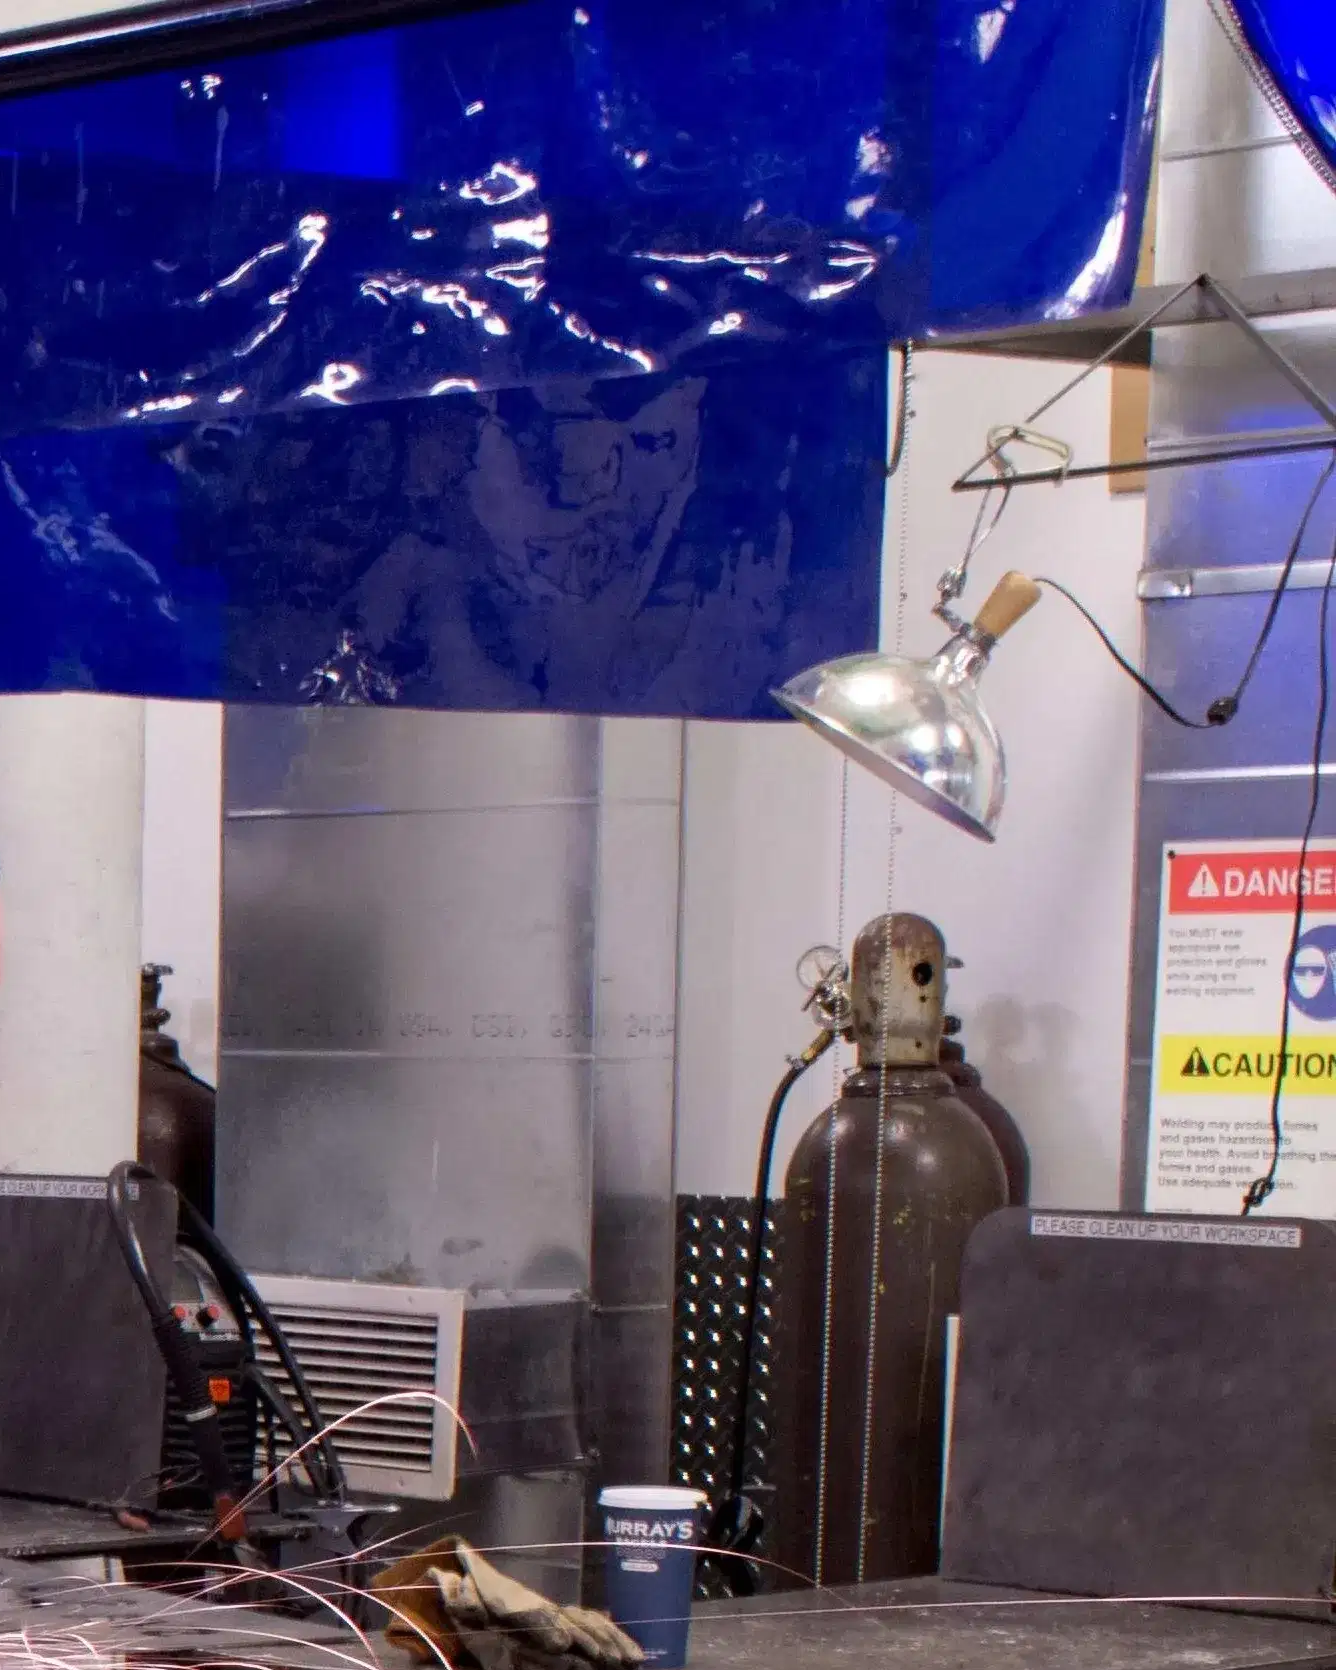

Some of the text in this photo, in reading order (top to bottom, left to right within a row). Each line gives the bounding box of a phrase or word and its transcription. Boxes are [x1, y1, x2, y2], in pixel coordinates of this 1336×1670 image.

[1224, 867, 1336, 897] DANGE
[1189, 927, 1217, 938] MUST
[1160, 1118, 1205, 1131] Welding
[1207, 1120, 1230, 1132] may
[1233, 1119, 1277, 1133] produc
[1160, 1132, 1180, 1143] and
[1182, 1134, 1216, 1146] gases
[1218, 1133, 1278, 1146] hazardou
[1159, 1150, 1185, 1161] your
[1226, 1149, 1260, 1160] Avoid
[1158, 1161, 1192, 1172] fumes
[1194, 1162, 1216, 1173] and
[1157, 1175, 1179, 1186] Use
[1181, 1176, 1232, 1189] adequate
[1034, 1217, 1298, 1244] PLEASE CLEAN UP YOUR WORKSPACE
